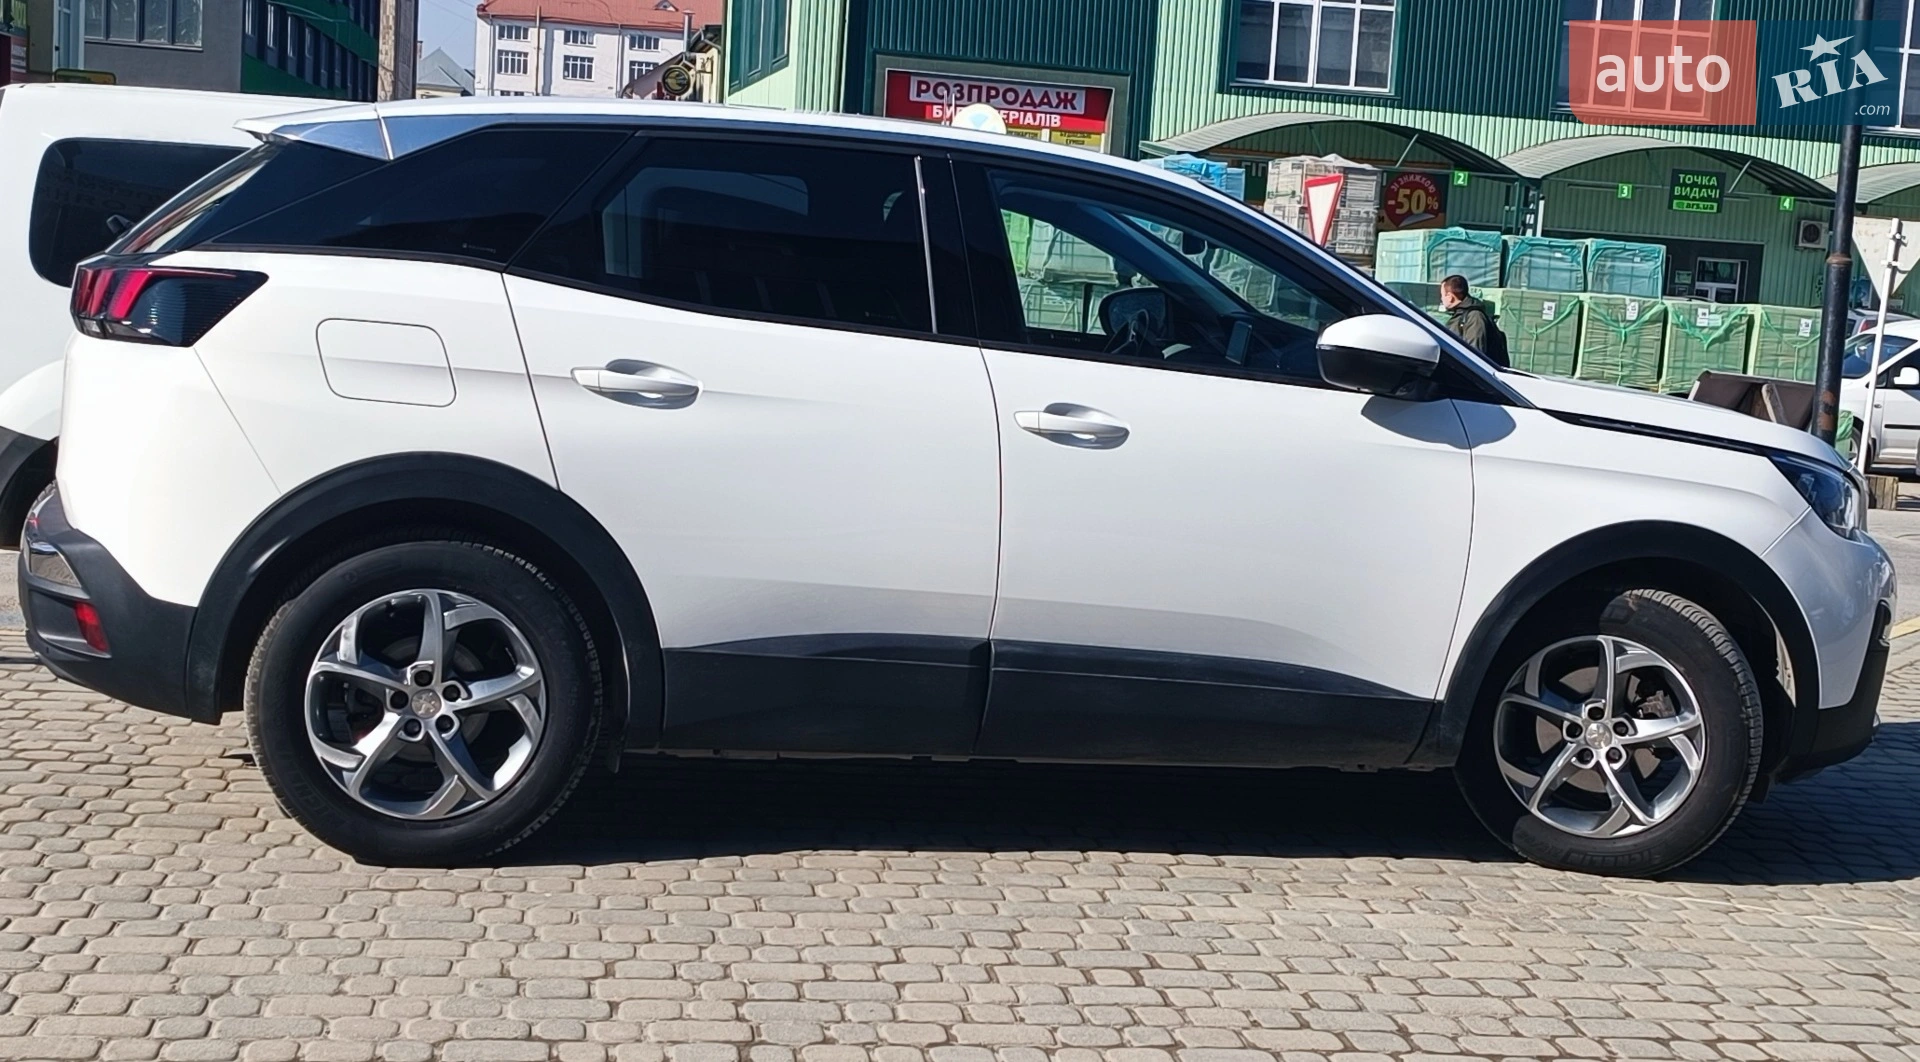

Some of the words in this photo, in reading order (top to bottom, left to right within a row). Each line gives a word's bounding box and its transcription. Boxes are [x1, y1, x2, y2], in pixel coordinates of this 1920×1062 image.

[915, 79, 1077, 111] РОЗПРОДАЖ
[1400, 174, 1436, 193] ЗНИЖКОЮ
[1457, 173, 1465, 184] 2
[1678, 174, 1718, 186] ТОЧКА
[1674, 186, 1720, 199] ВИДАЧІ
[1387, 188, 1439, 215] -50%
[1685, 202, 1715, 211] ars.ua
